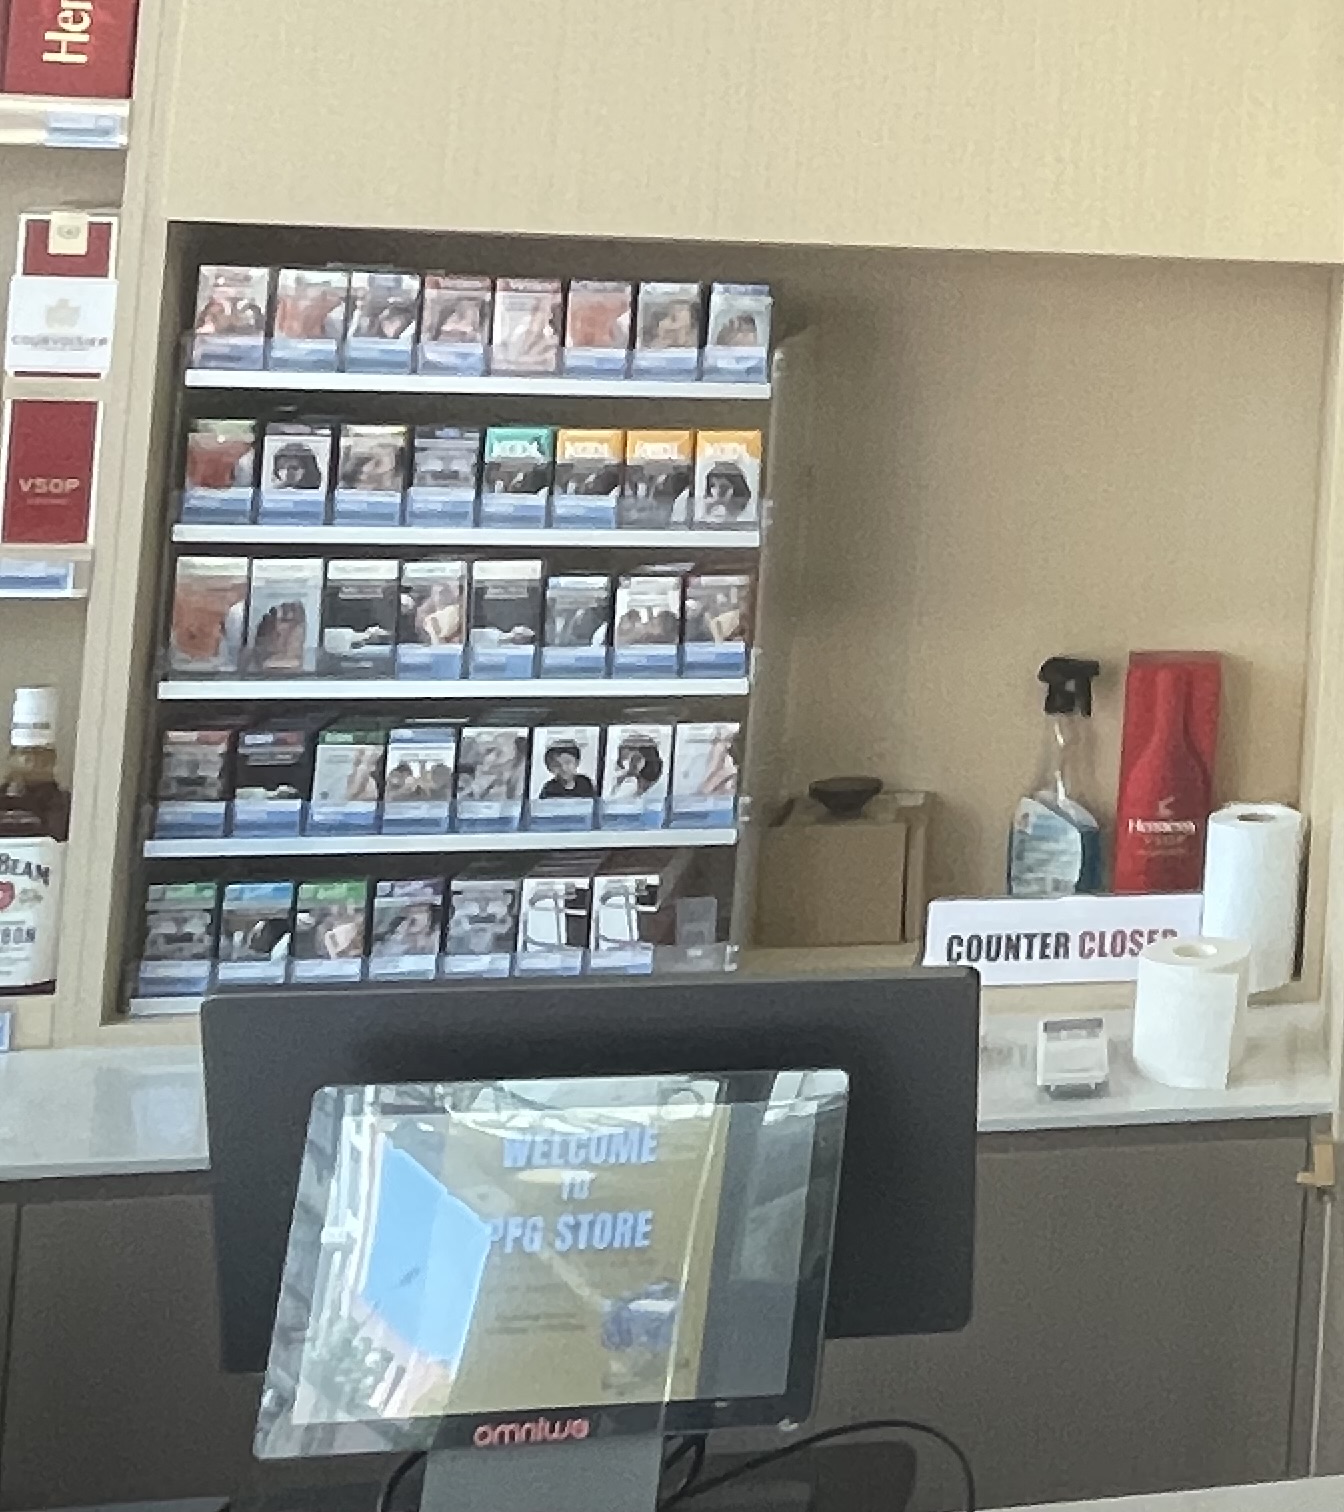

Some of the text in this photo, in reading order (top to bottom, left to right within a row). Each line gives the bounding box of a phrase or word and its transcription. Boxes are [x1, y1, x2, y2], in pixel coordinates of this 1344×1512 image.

[946, 932, 1070, 963] COUNTER
[503, 1124, 657, 1168] WELCOME
[555, 1209, 653, 1252] STORE
